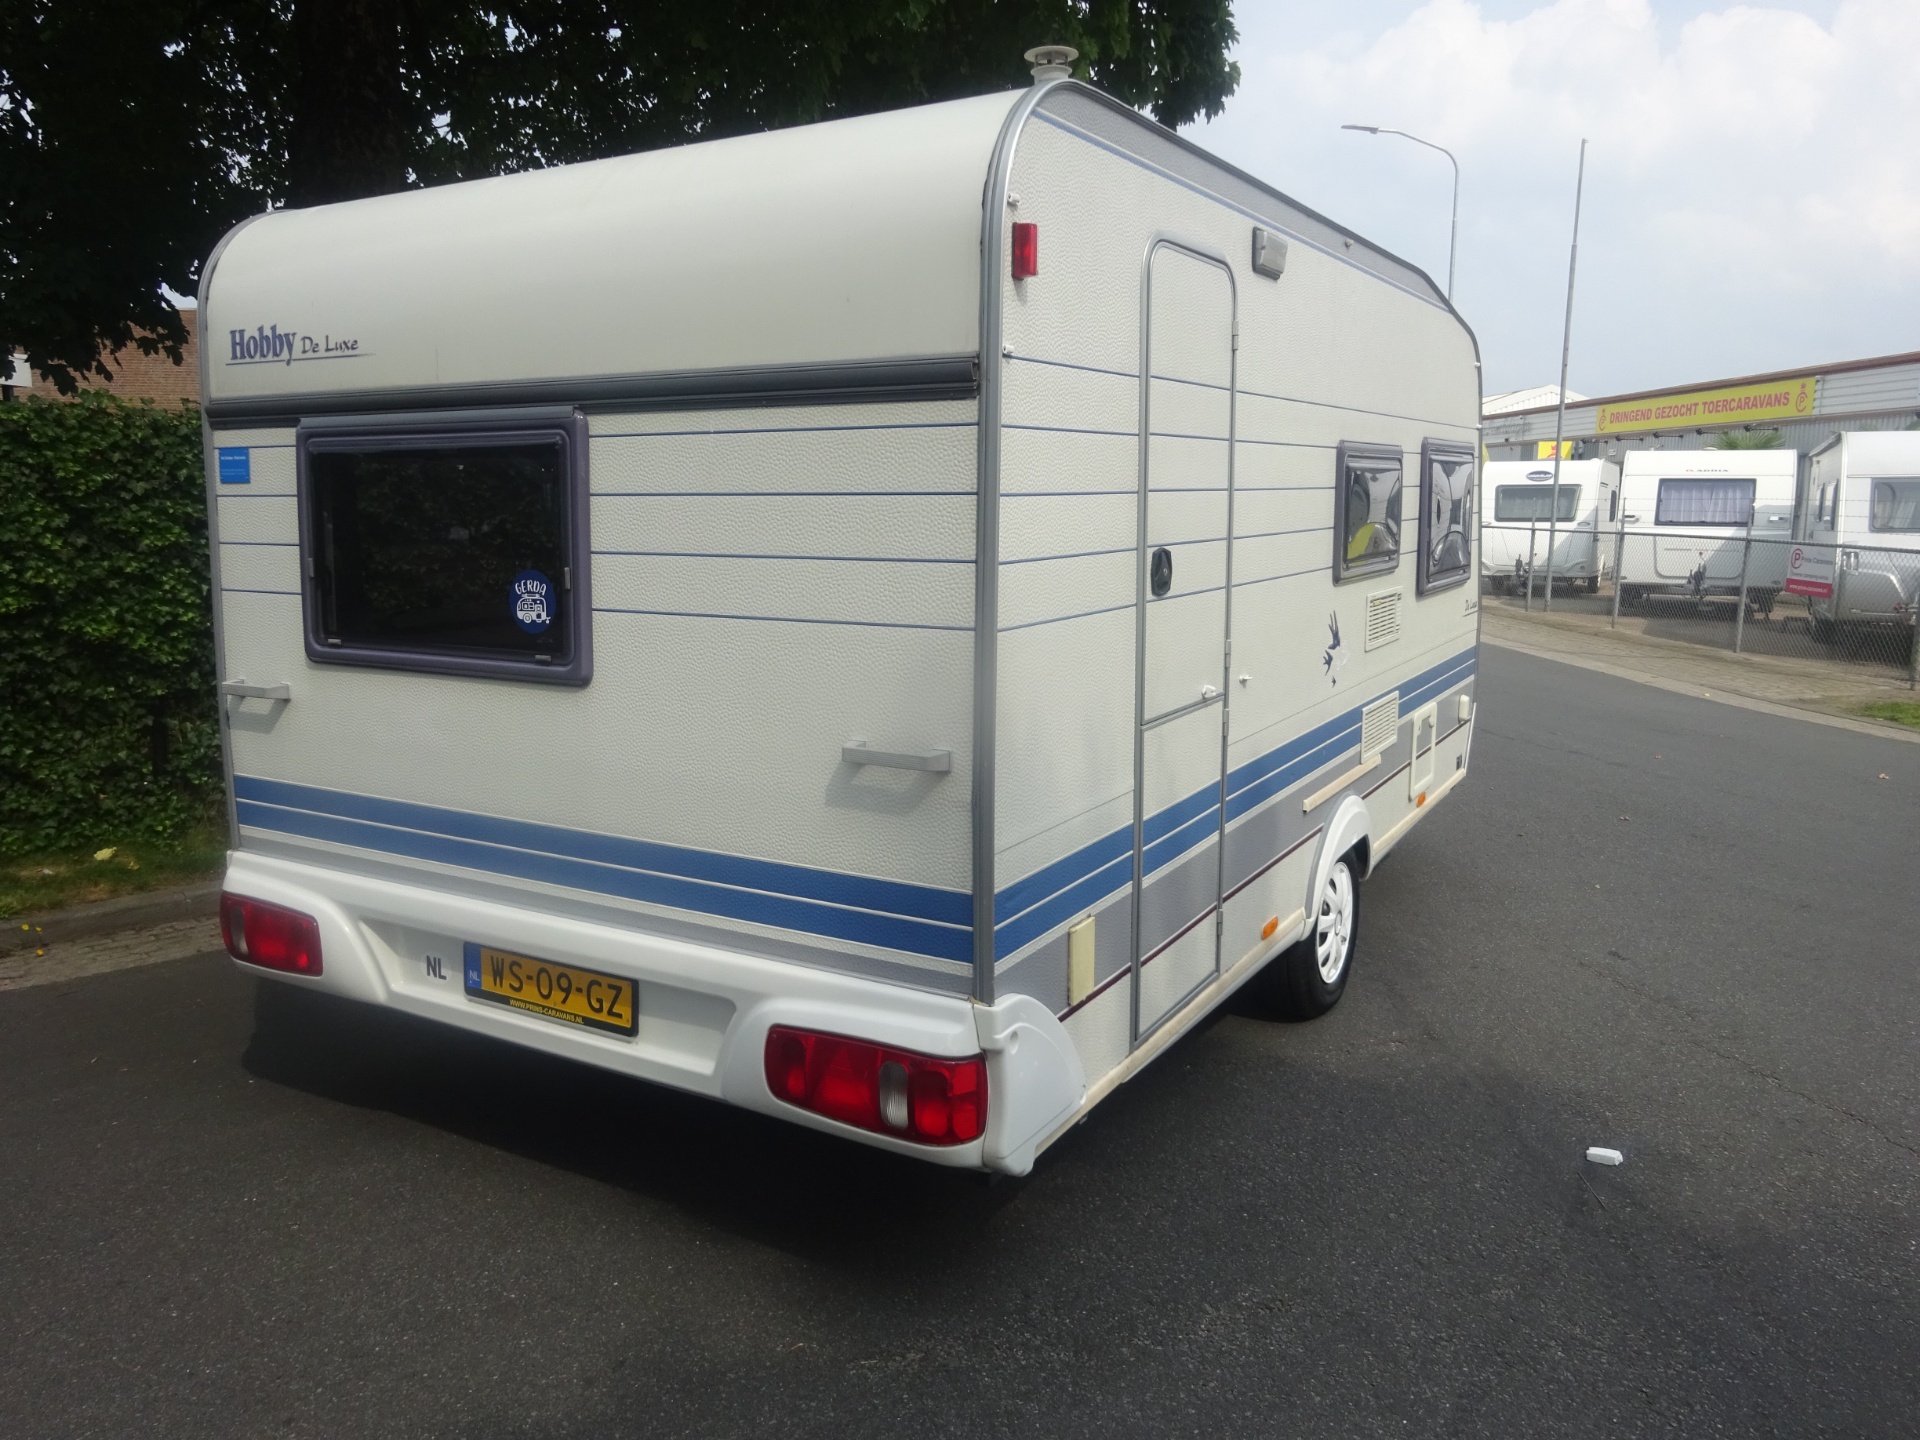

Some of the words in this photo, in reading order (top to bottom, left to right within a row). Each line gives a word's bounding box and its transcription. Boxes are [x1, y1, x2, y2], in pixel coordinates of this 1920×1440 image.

[229, 324, 297, 366] Hobby
[301, 336, 320, 354] De
[325, 335, 359, 353] Luxe
[1609, 407, 1653, 425] DRINGEND
[1655, 402, 1699, 420] GEZOCHT
[1702, 392, 1790, 414] TOERCARAVANS
[514, 579, 547, 596] GERDA
[426, 954, 447, 981] NL
[469, 969, 480, 982] NL
[490, 954, 624, 1019] WS-09-GZ
[509, 998, 585, 1025] WWW.PRINS-CARAVANS.NL
